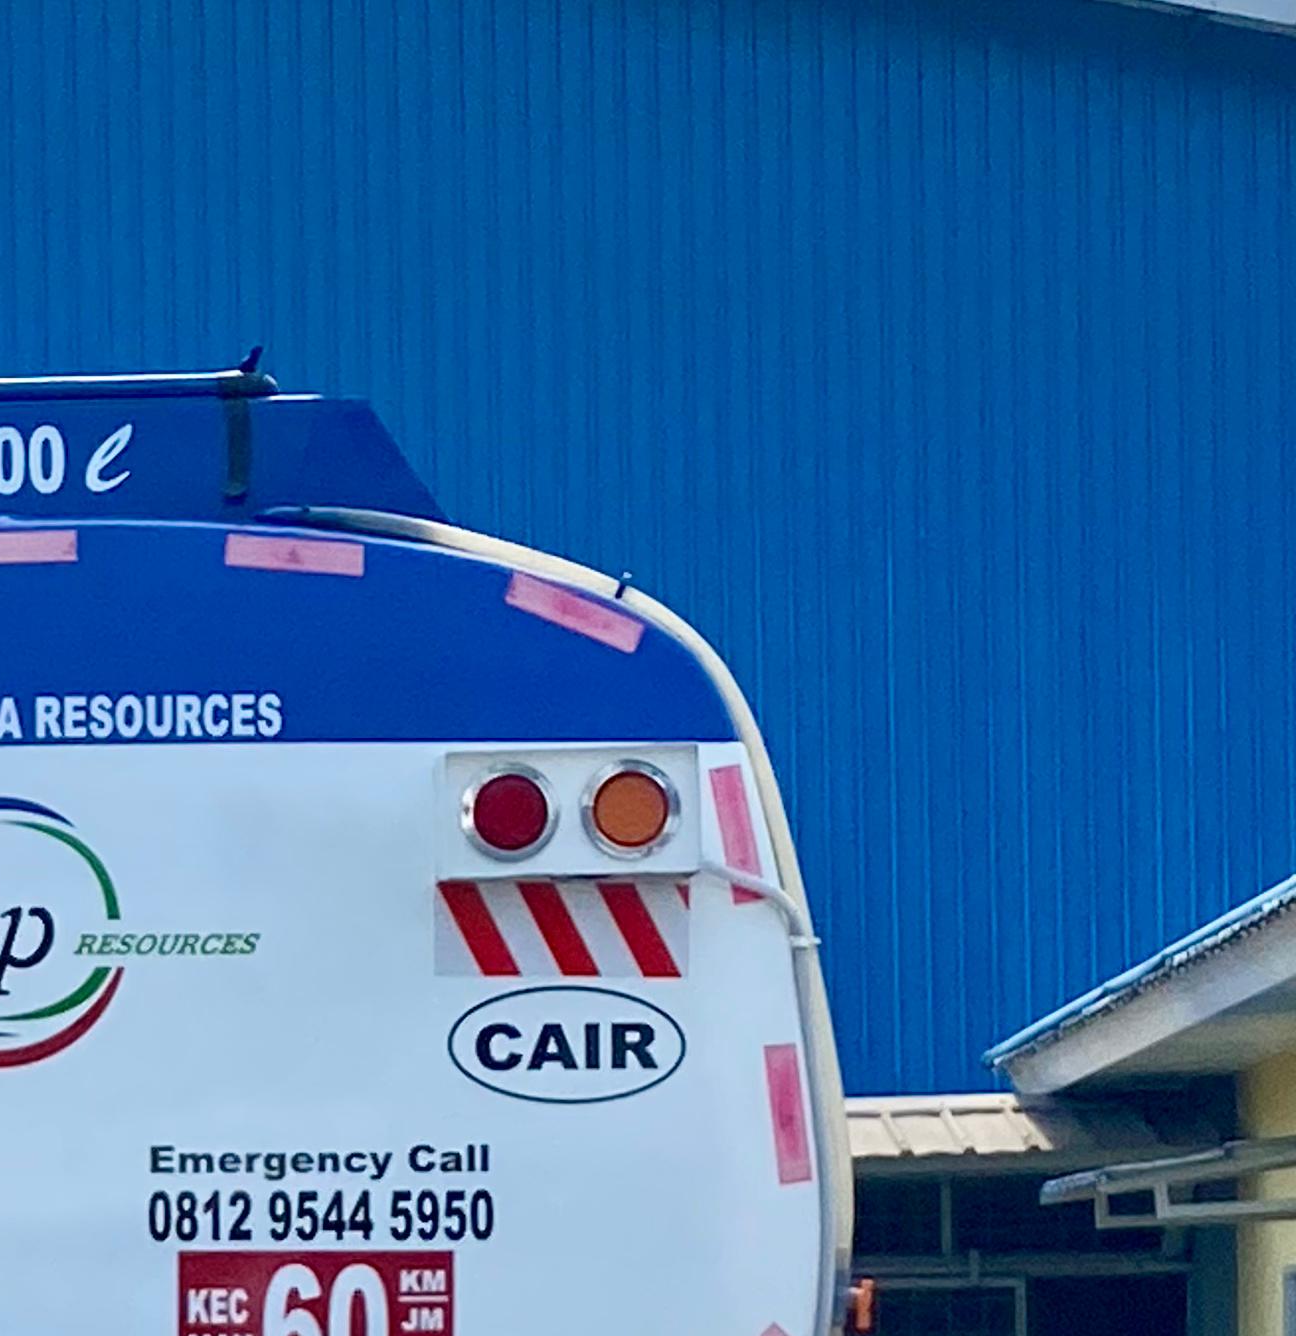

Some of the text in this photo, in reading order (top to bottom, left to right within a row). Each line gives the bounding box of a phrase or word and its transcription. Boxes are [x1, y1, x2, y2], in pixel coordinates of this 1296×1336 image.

[35, 693, 283, 740] RESOURCES
[73, 933, 260, 956] RESOURCES
[475, 1023, 659, 1070] CAIR
[150, 1144, 490, 1180] Emergency Call
[149, 1189, 495, 1242] 0812 9544 5950
[400, 1269, 447, 1293] KM
[187, 1288, 250, 1325] KEC
[401, 1307, 445, 1332] JM
